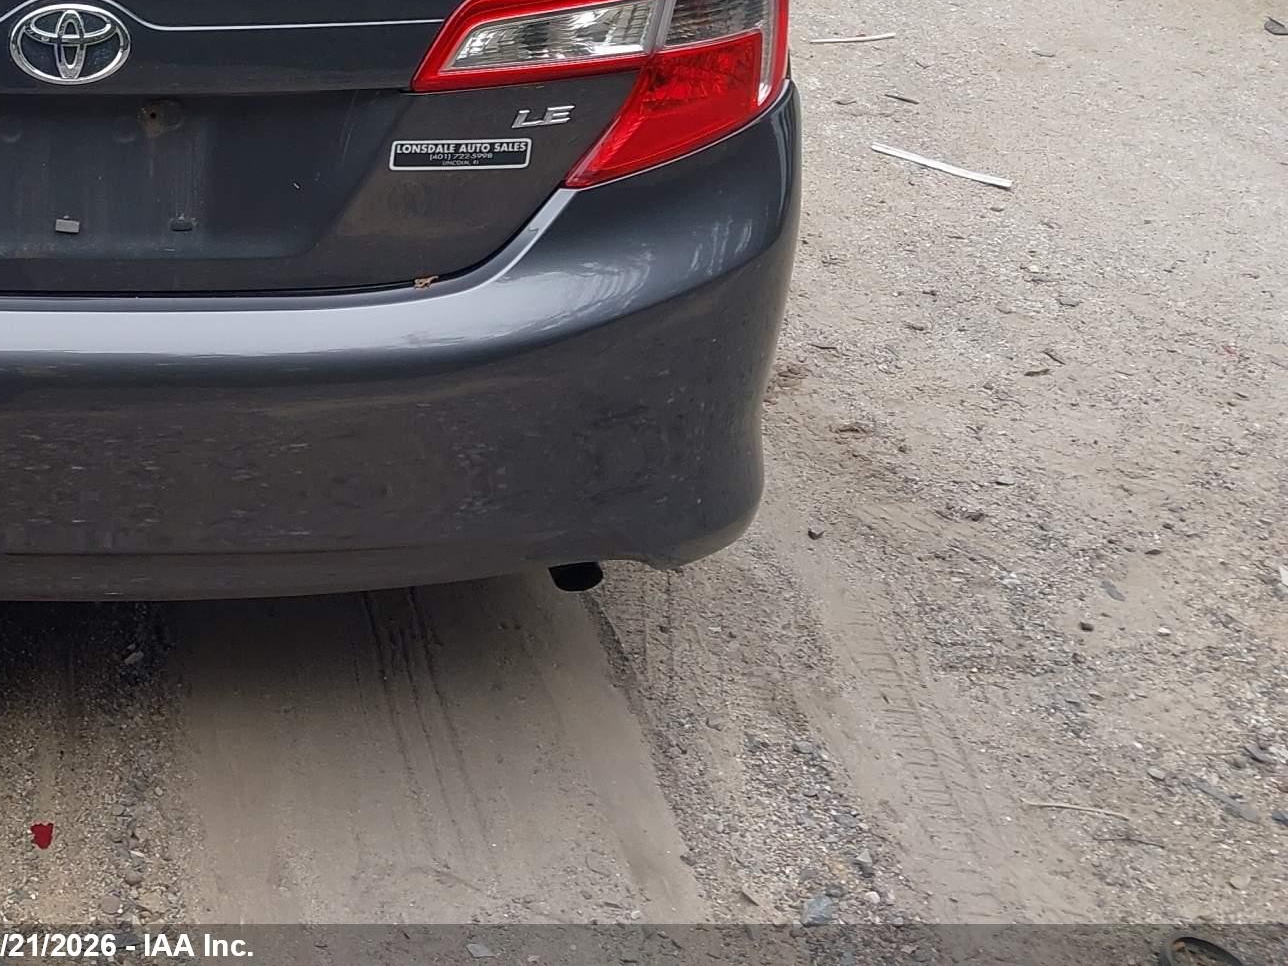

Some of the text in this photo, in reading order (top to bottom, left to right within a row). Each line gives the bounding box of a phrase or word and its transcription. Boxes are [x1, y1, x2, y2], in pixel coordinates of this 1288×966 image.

[511, 105, 575, 129] LE
[396, 142, 526, 154] LONSDALE AUTO SALES
[429, 153, 451, 161] (401)
